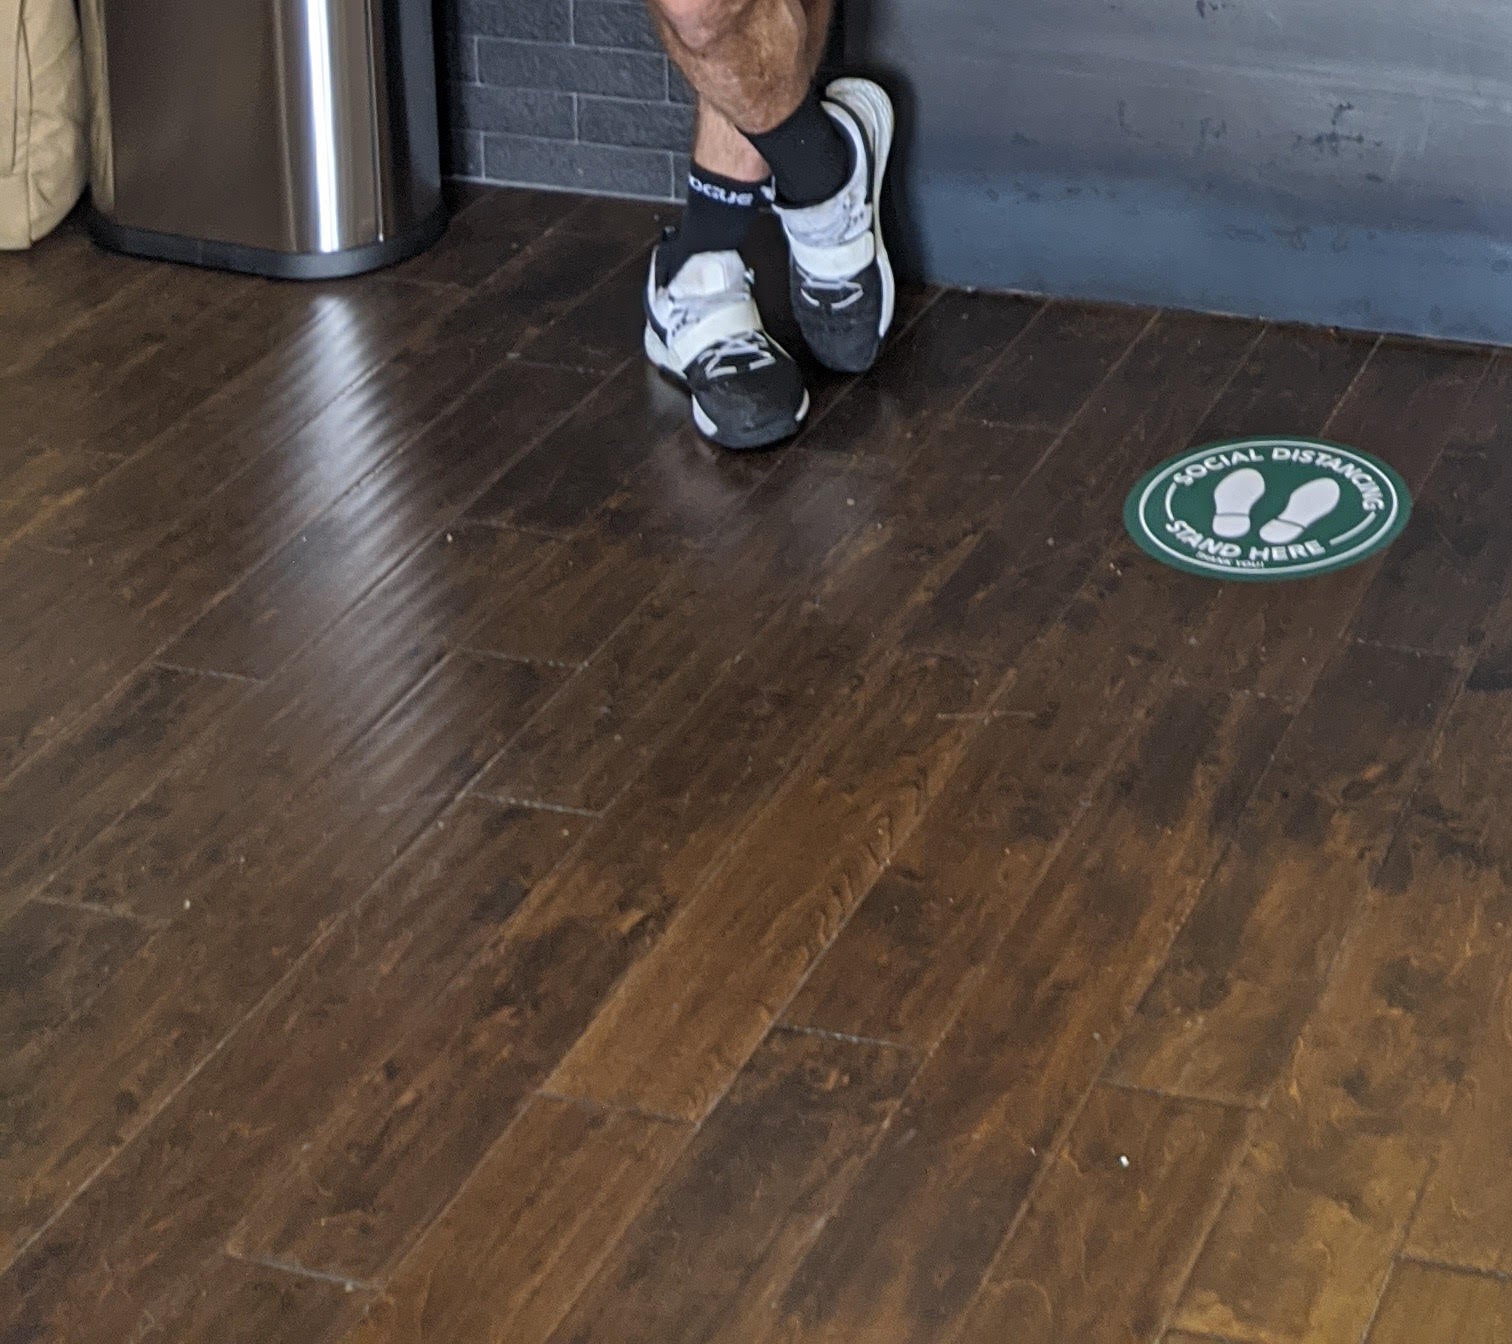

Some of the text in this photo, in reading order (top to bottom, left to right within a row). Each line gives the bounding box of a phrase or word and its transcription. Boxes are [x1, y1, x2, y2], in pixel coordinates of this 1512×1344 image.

[1173, 447, 1385, 512] SOCIAL DISTANCING
[1165, 519, 1327, 562] STAND HERE
